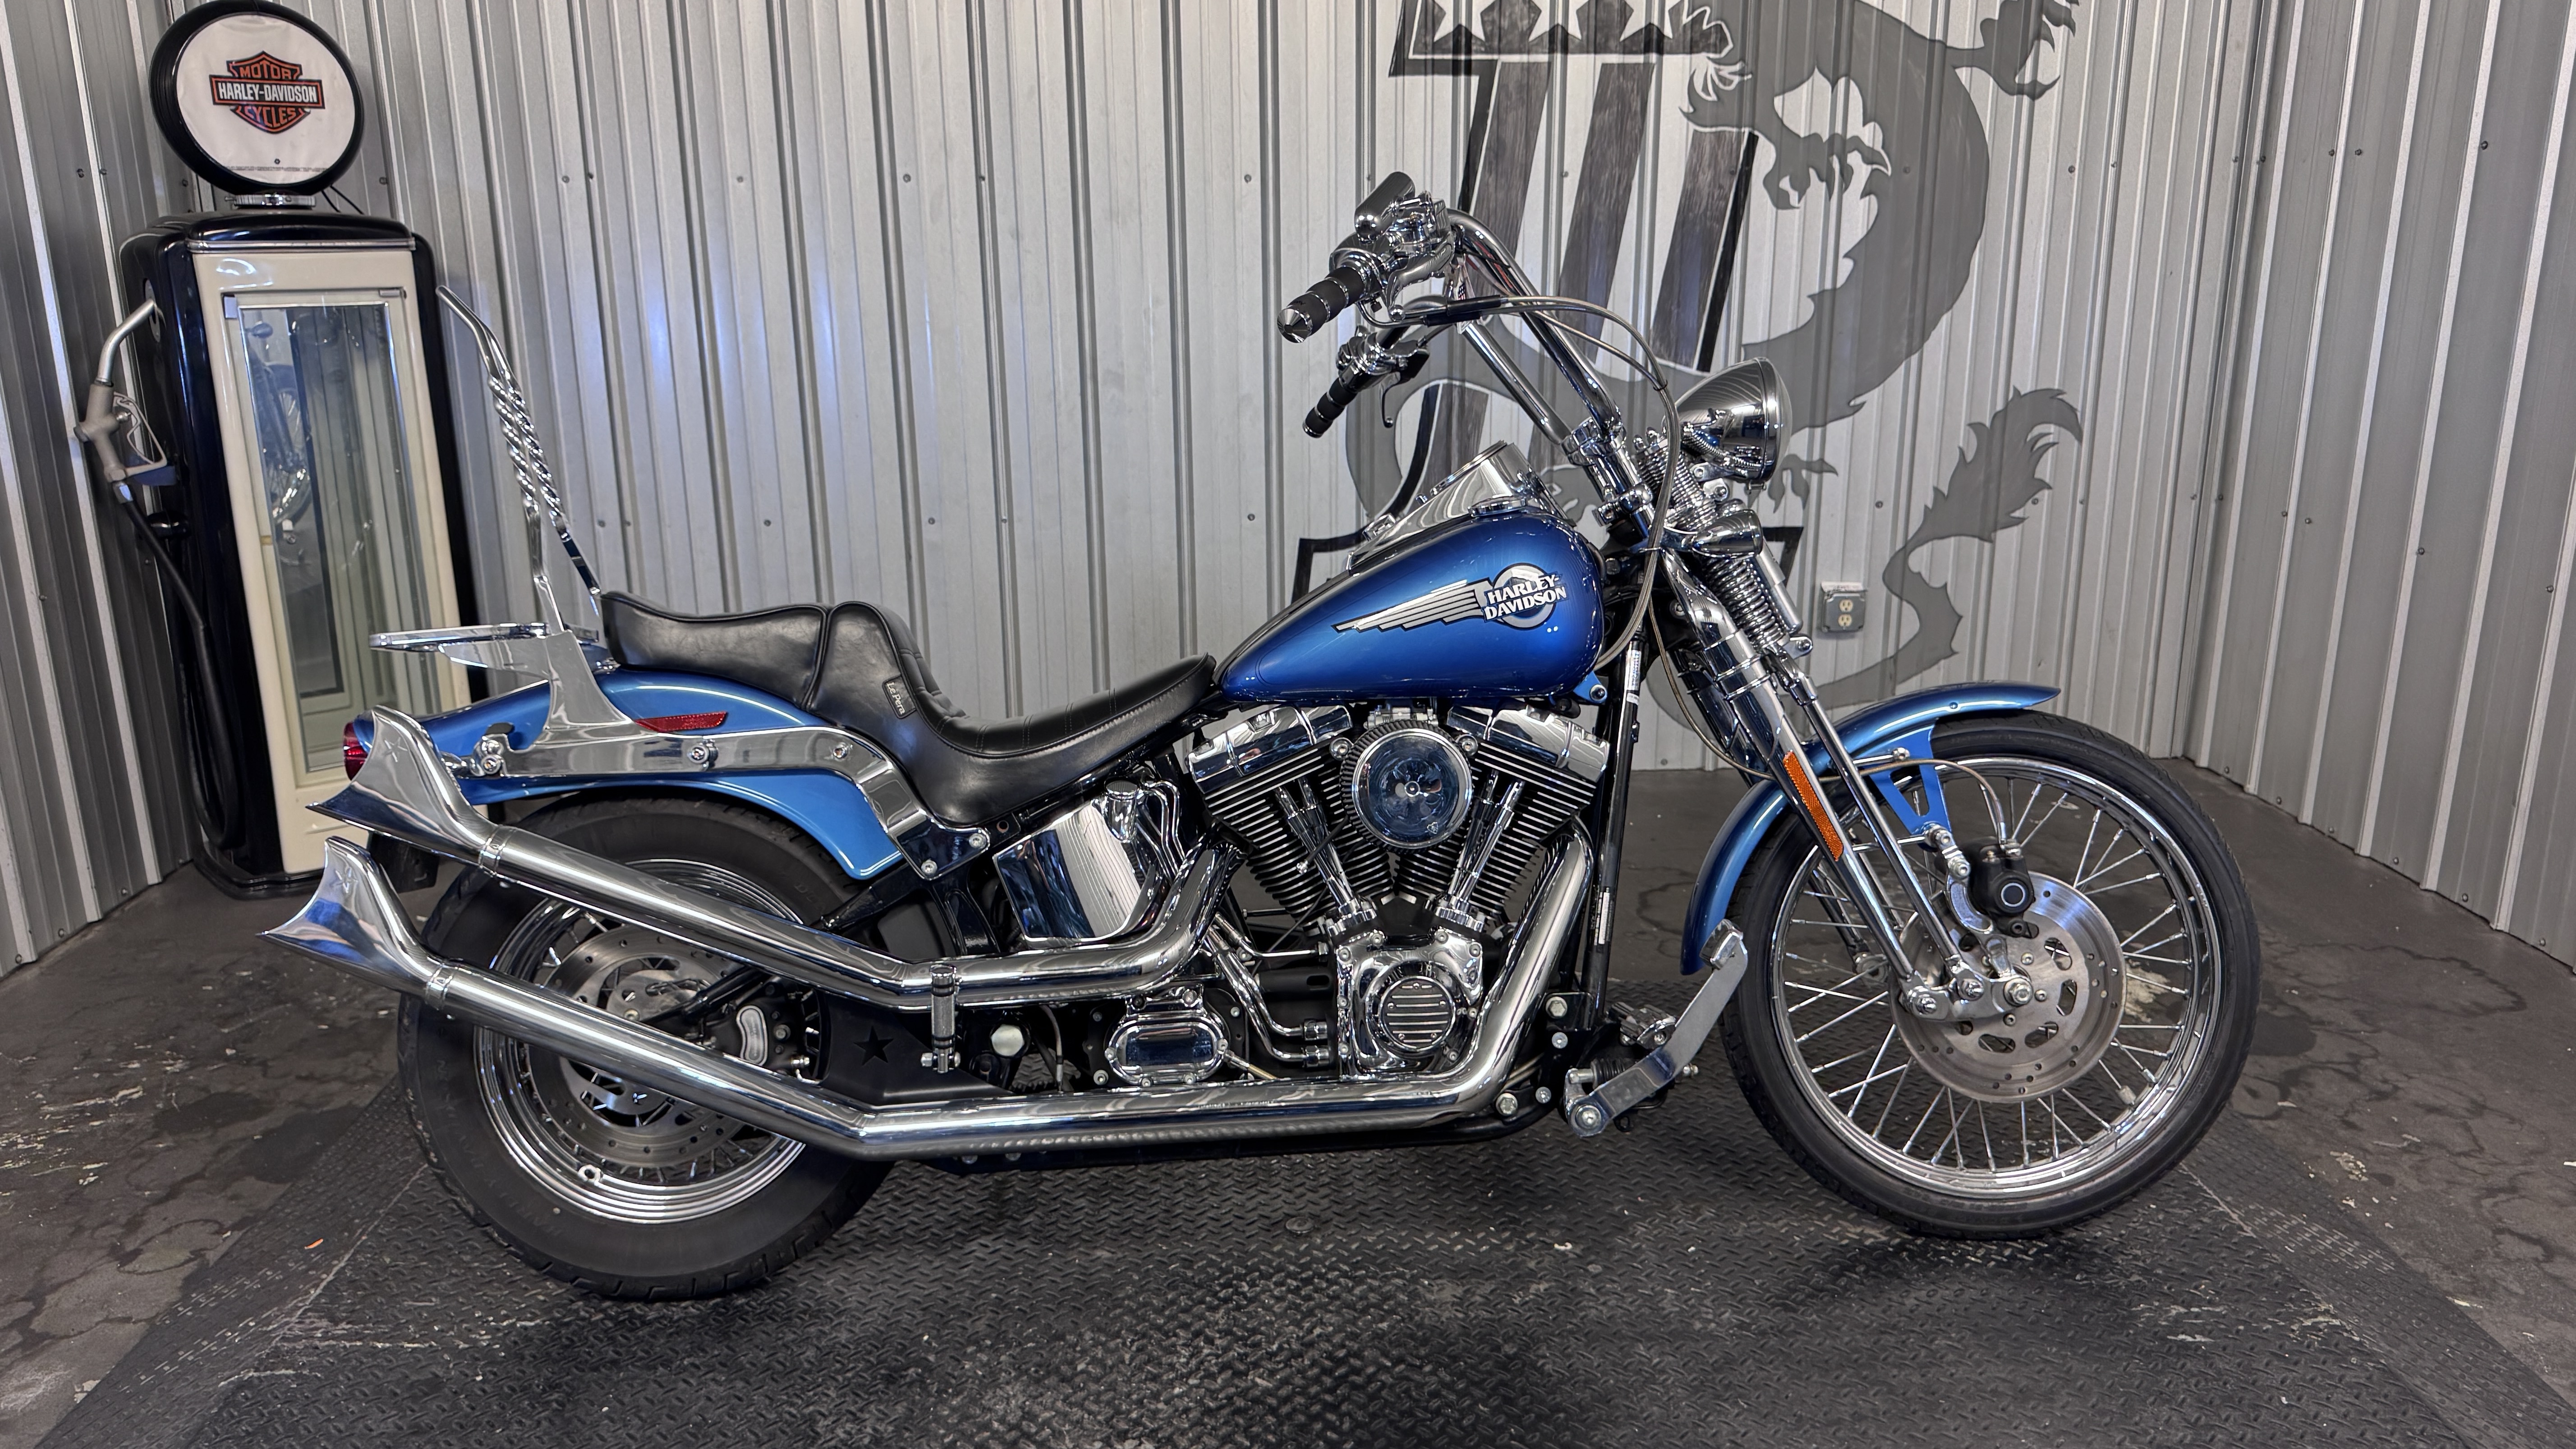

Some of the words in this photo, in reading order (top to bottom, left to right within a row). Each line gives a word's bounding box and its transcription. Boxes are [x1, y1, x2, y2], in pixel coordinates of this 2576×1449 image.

[240, 61, 291, 79] MOTOR
[218, 82, 317, 102] HARLEY-DAVIDSON
[244, 106, 297, 127] CYCLES
[1487, 574, 1559, 604] HARLEY-
[1484, 586, 1567, 620] DAVIDSON
